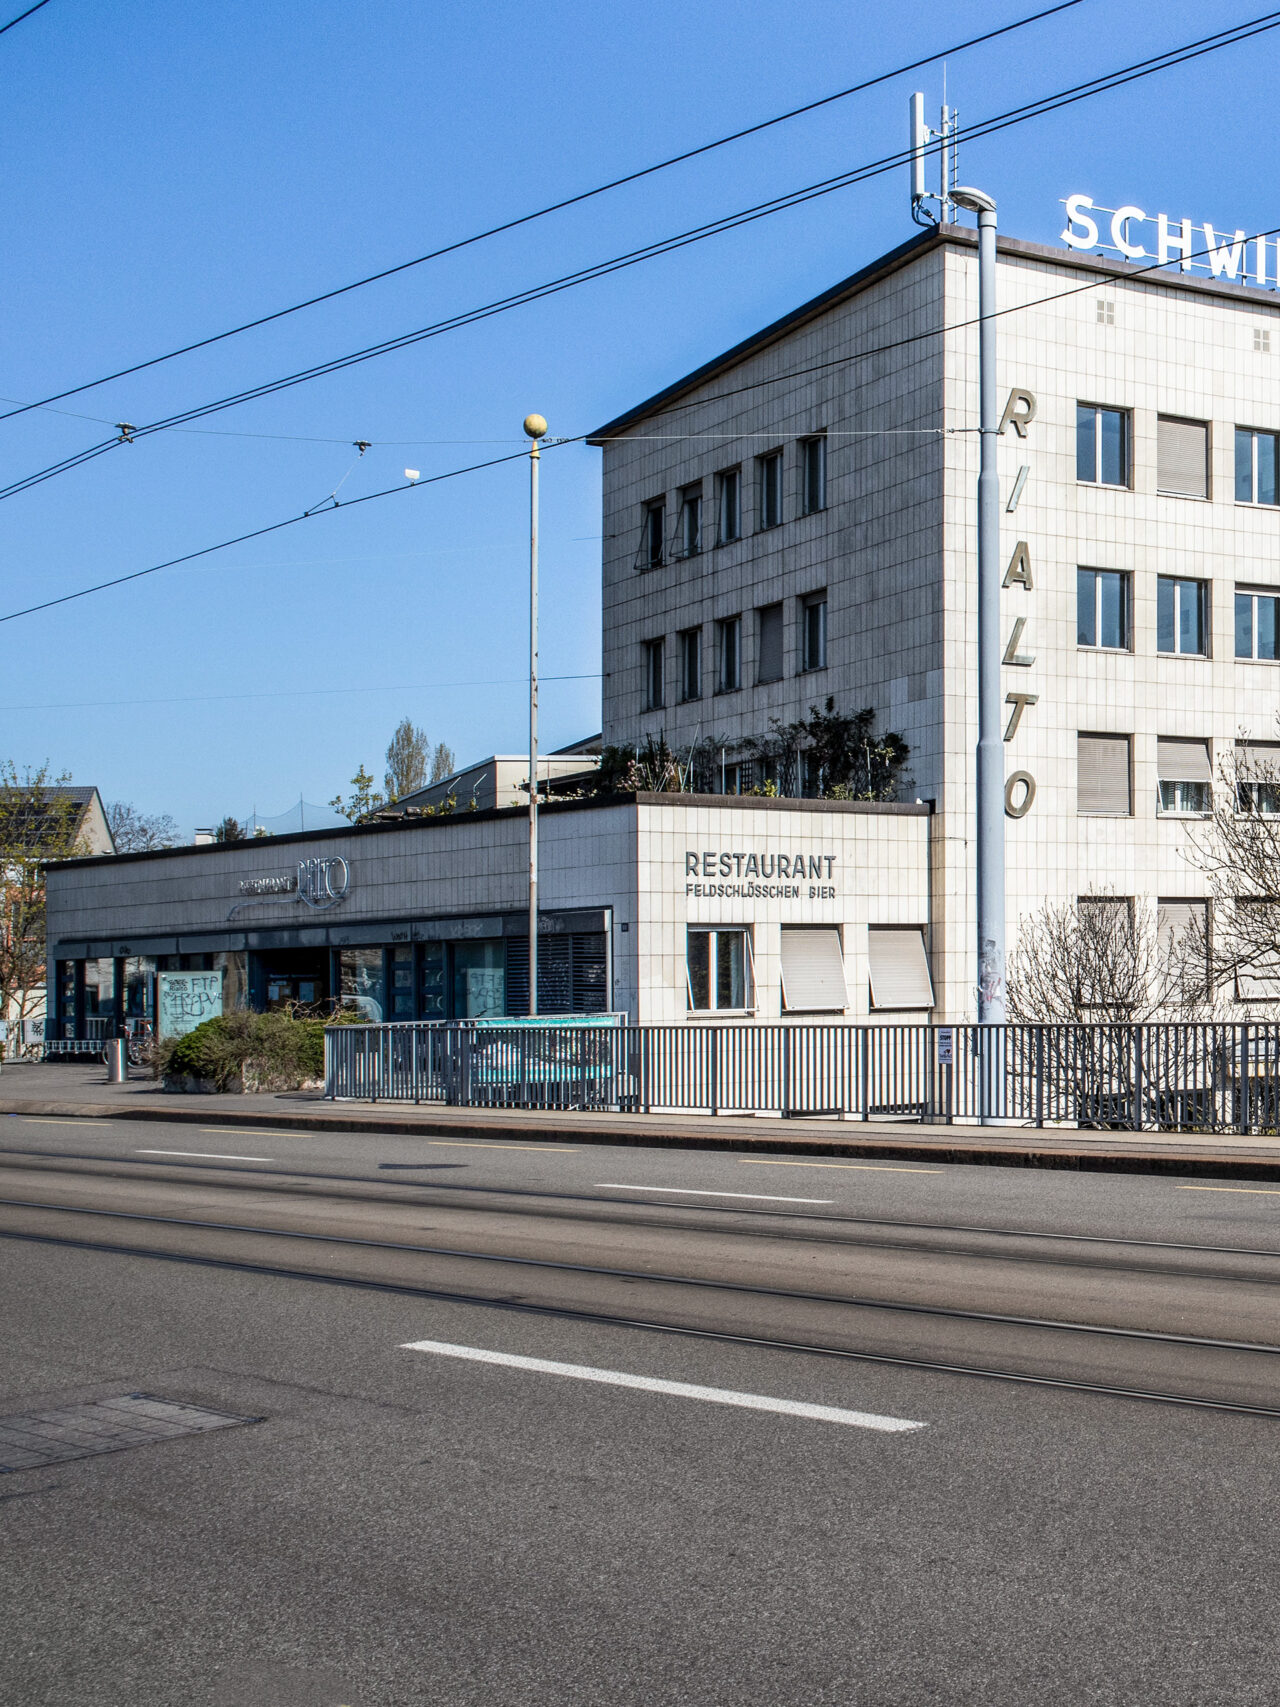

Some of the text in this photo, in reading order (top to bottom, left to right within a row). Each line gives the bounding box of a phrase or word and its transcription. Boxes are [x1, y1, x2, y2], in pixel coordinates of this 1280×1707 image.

[999, 387, 1040, 819] RIALTO
[685, 851, 837, 880] RESTAURANT
[685, 881, 836, 899] FELDSCHLÖSSCHEN BIER
